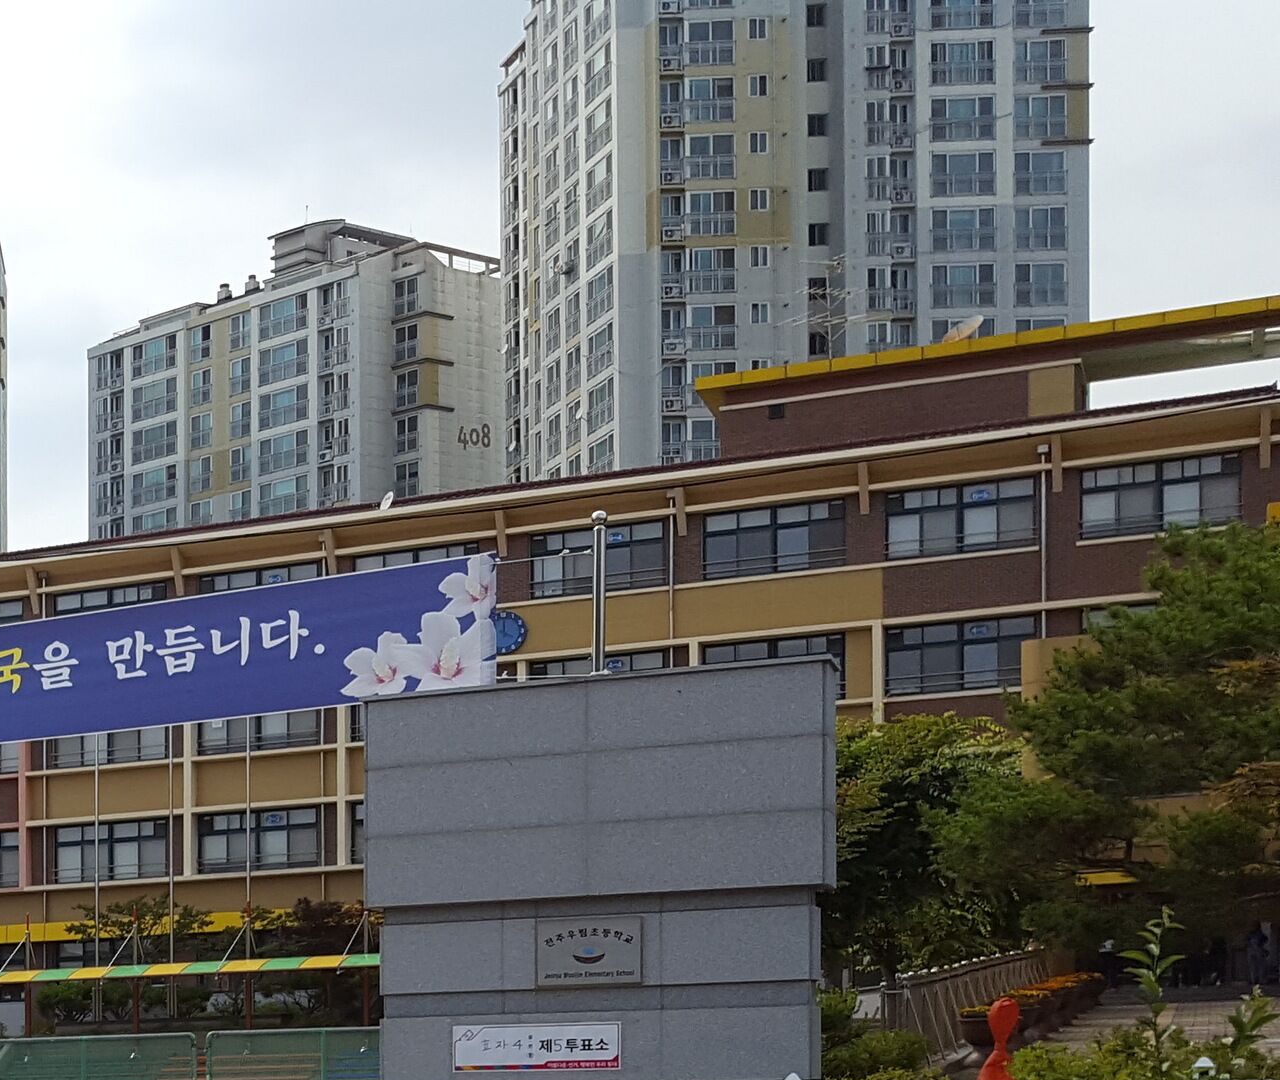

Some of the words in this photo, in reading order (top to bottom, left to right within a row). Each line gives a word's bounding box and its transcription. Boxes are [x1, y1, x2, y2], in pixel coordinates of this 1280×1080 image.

[457, 423, 491, 450] 408
[107, 609, 327, 680] 만듭니다.
[544, 928, 635, 948] 전주우림초등학교
[538, 1037, 610, 1054] 제5투표소
